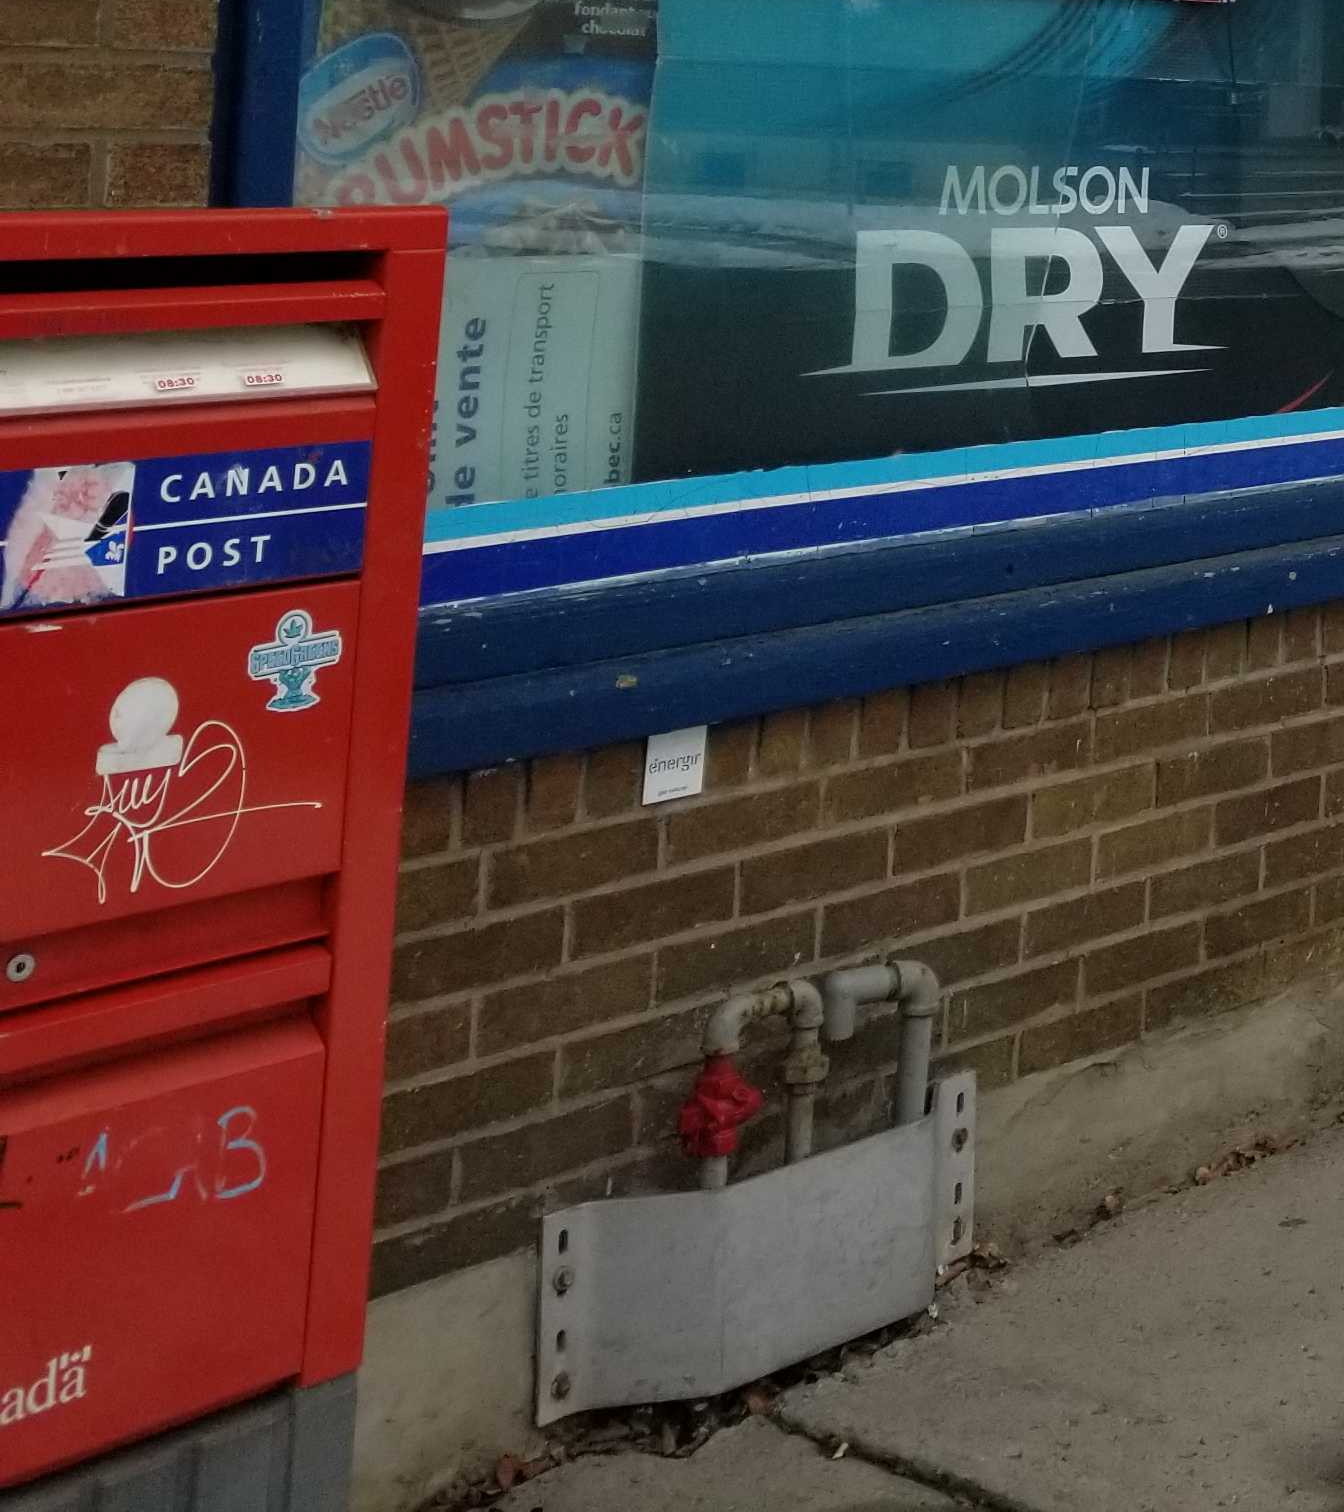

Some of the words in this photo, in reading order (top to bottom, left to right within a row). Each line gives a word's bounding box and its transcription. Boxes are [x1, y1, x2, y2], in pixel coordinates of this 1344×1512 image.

[938, 165, 1150, 217] MOLSON
[828, 224, 1220, 372] DRY
[528, 283, 556, 384] transport
[157, 377, 195, 389] 08:30
[246, 373, 283, 385] 08:30
[456, 317, 487, 448] vente
[523, 391, 542, 418] de
[520, 425, 541, 480] titres
[160, 459, 349, 504] CANADA
[157, 534, 272, 575] POST
